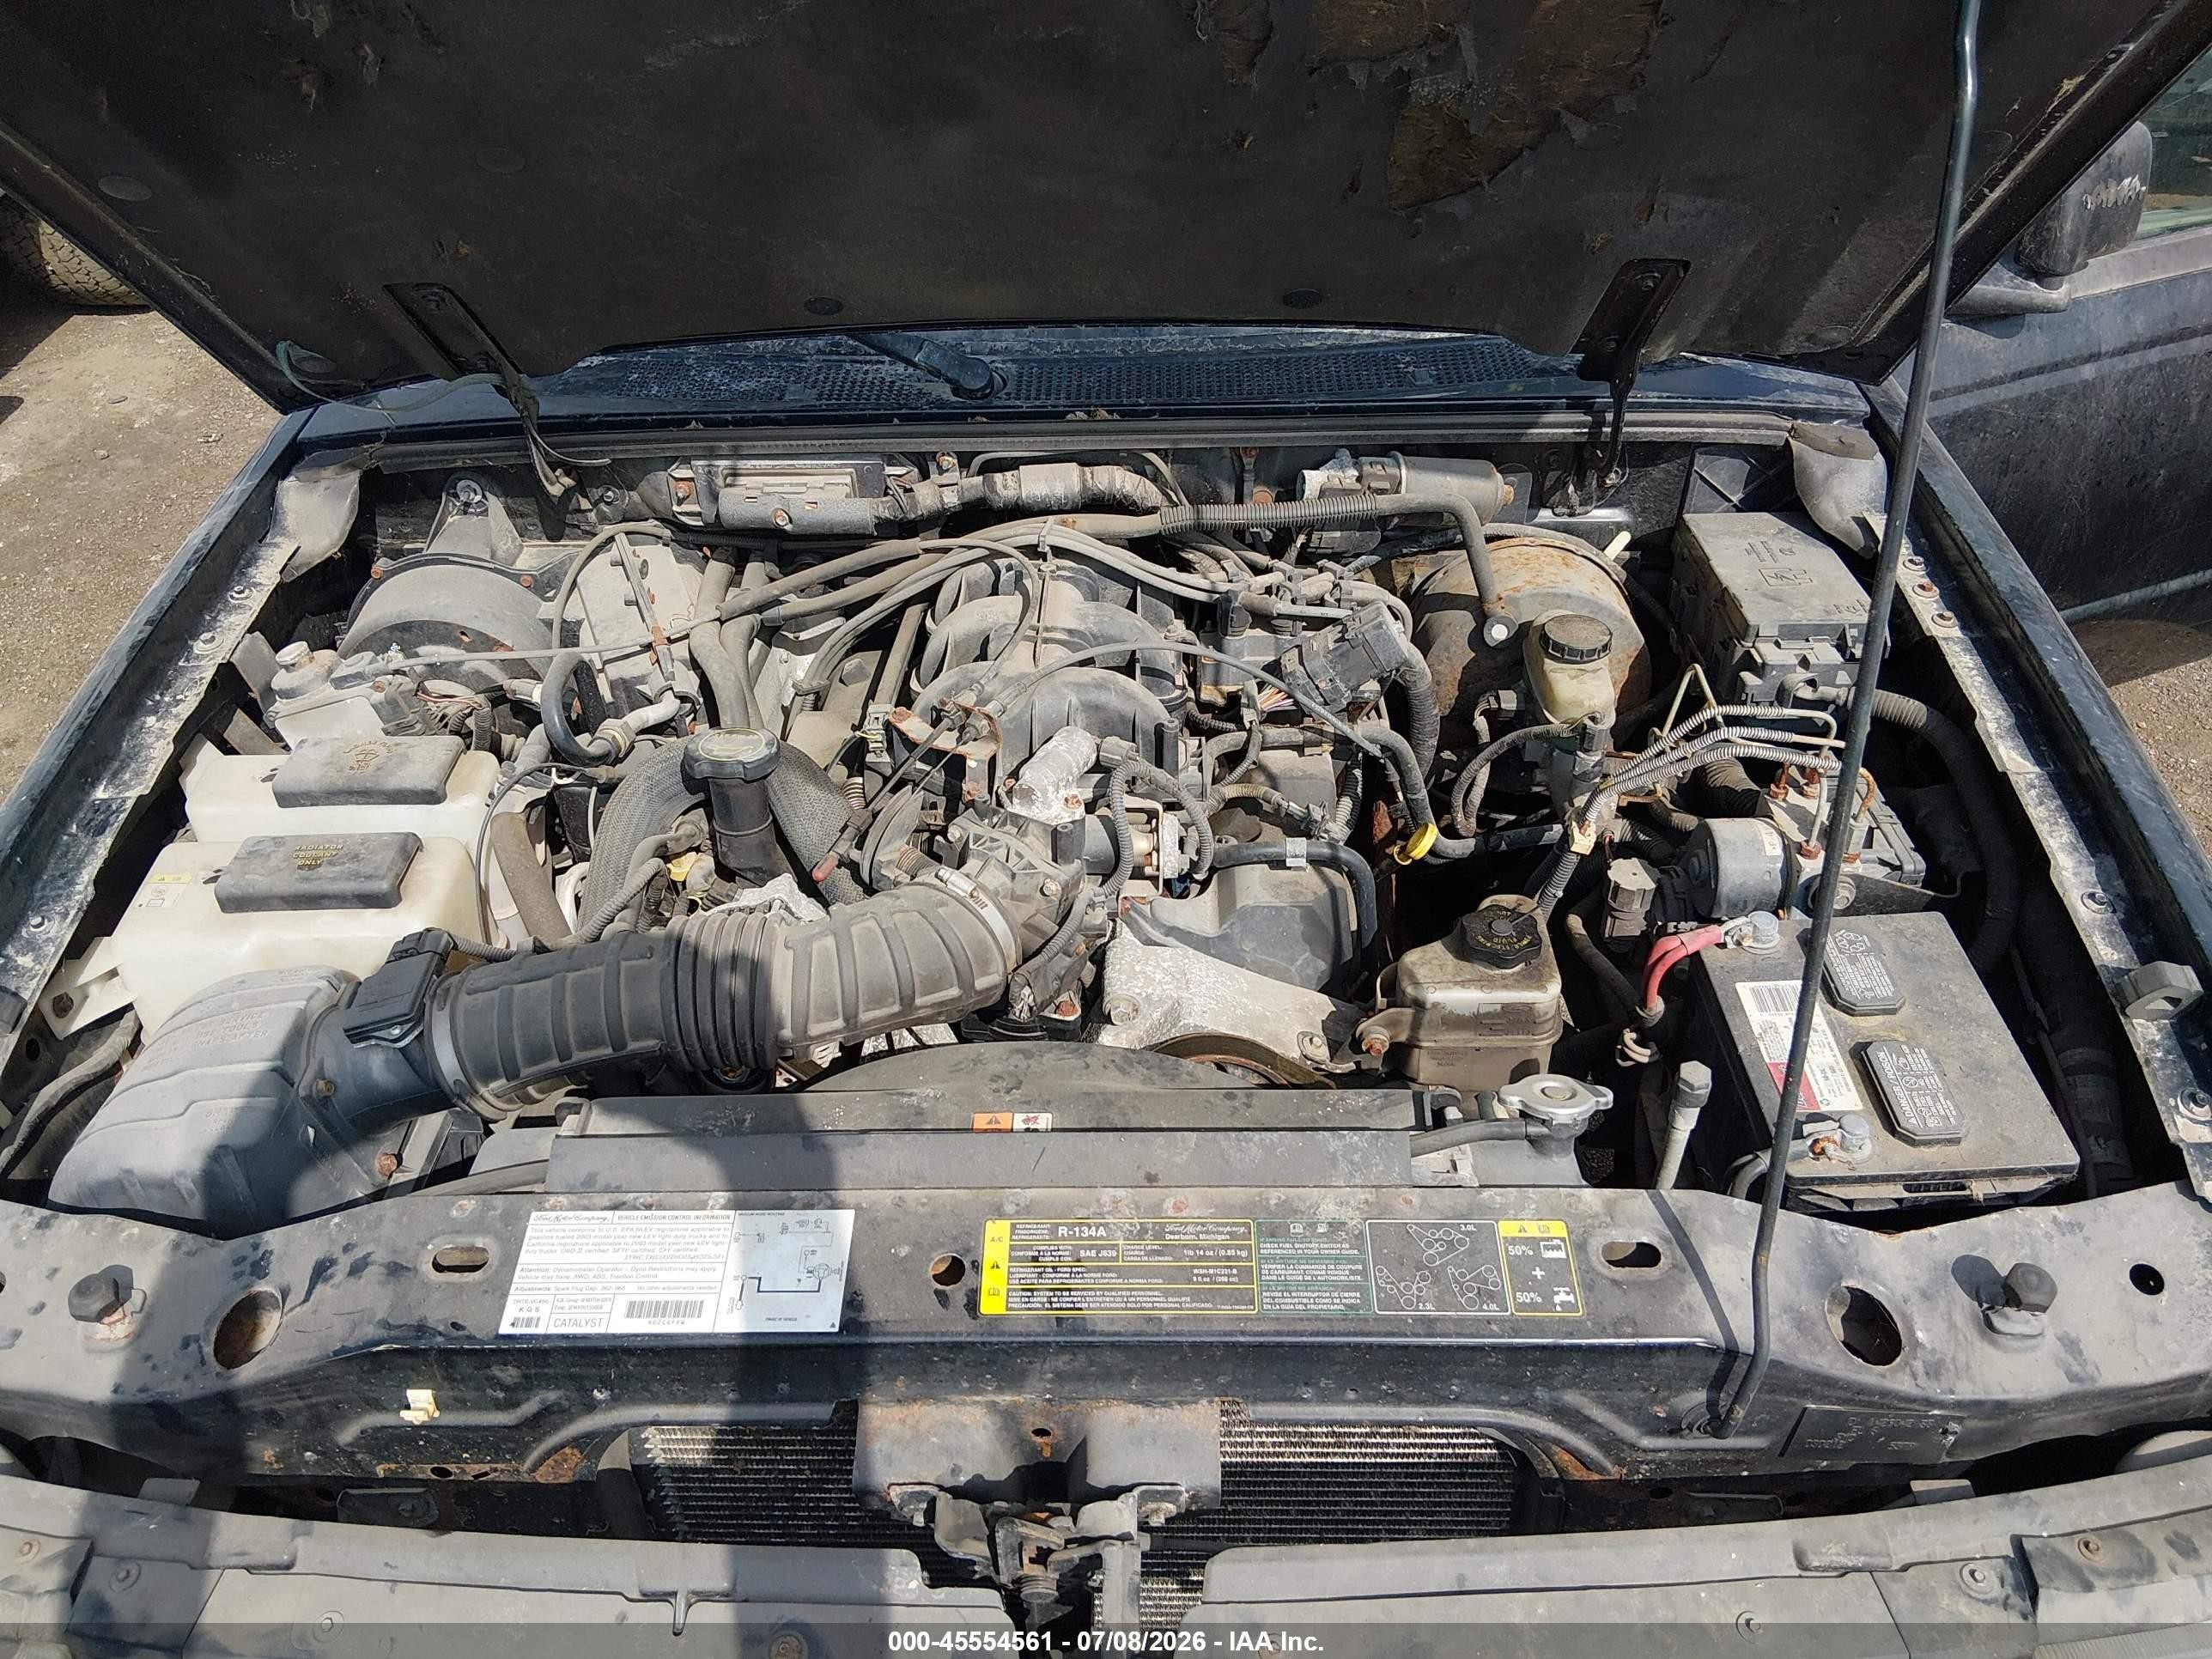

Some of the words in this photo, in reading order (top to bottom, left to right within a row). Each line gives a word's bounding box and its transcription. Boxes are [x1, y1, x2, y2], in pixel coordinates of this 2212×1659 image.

[1058, 1226, 1107, 1237] R-134A
[1508, 1245, 1534, 1255] 50%
[1516, 1291, 1542, 1303] 50%
[553, 1317, 605, 1328] CATALYST
